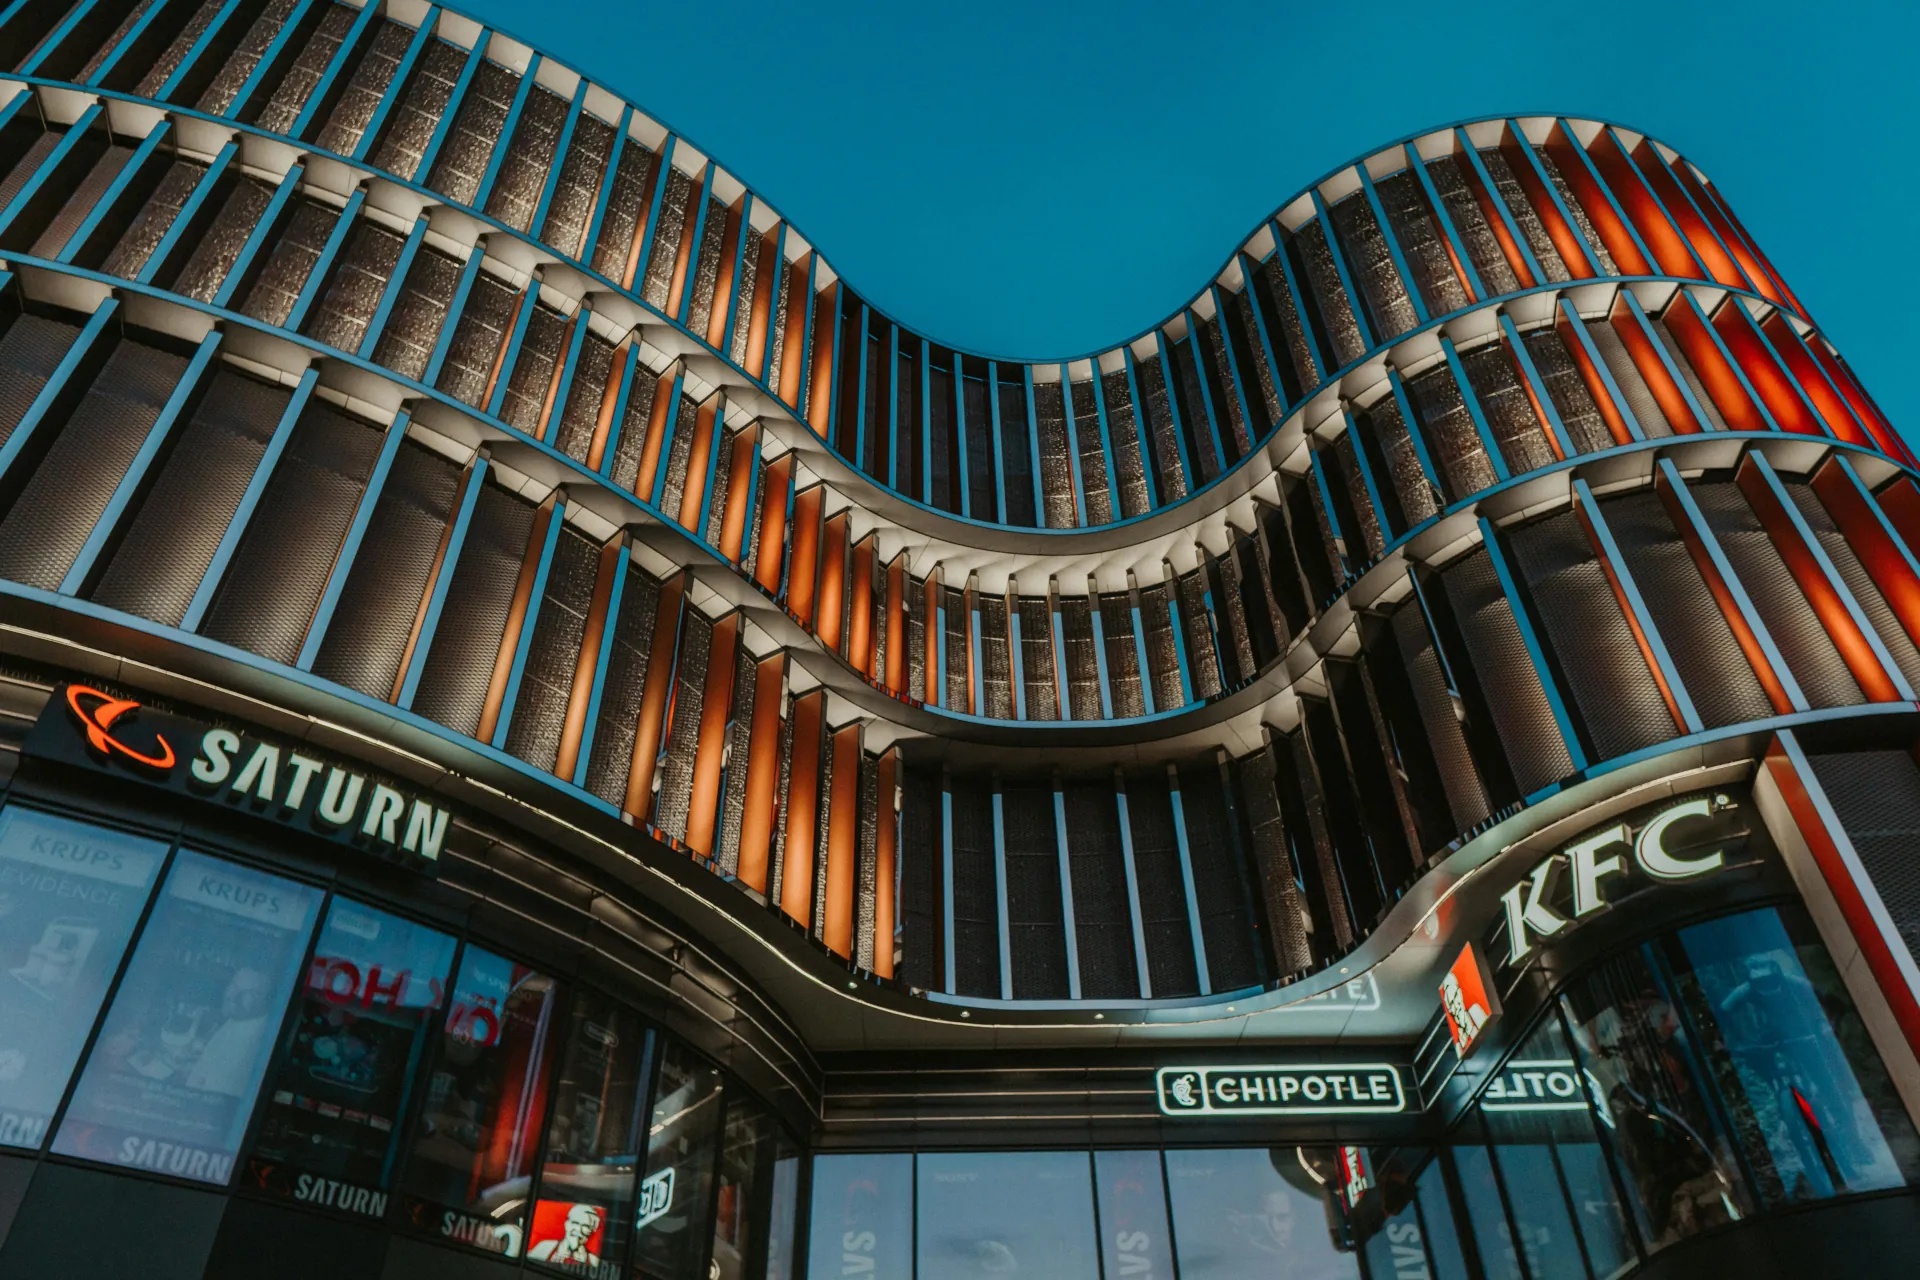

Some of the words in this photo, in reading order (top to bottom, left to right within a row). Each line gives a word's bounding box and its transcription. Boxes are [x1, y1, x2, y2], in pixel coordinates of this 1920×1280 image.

[191, 728, 450, 861] SATURN
[30, 834, 125, 870] KRUPS
[0, 864, 122, 909] EVIDENCE
[198, 875, 280, 914] KRUPS
[1500, 799, 1723, 967] KFC
[1214, 1075, 1392, 1103] CHIPOTLE
[117, 1135, 232, 1181] SATURN
[293, 1172, 389, 1219] SATURN
[841, 1231, 877, 1280] SA
[1115, 1231, 1154, 1280] SA
